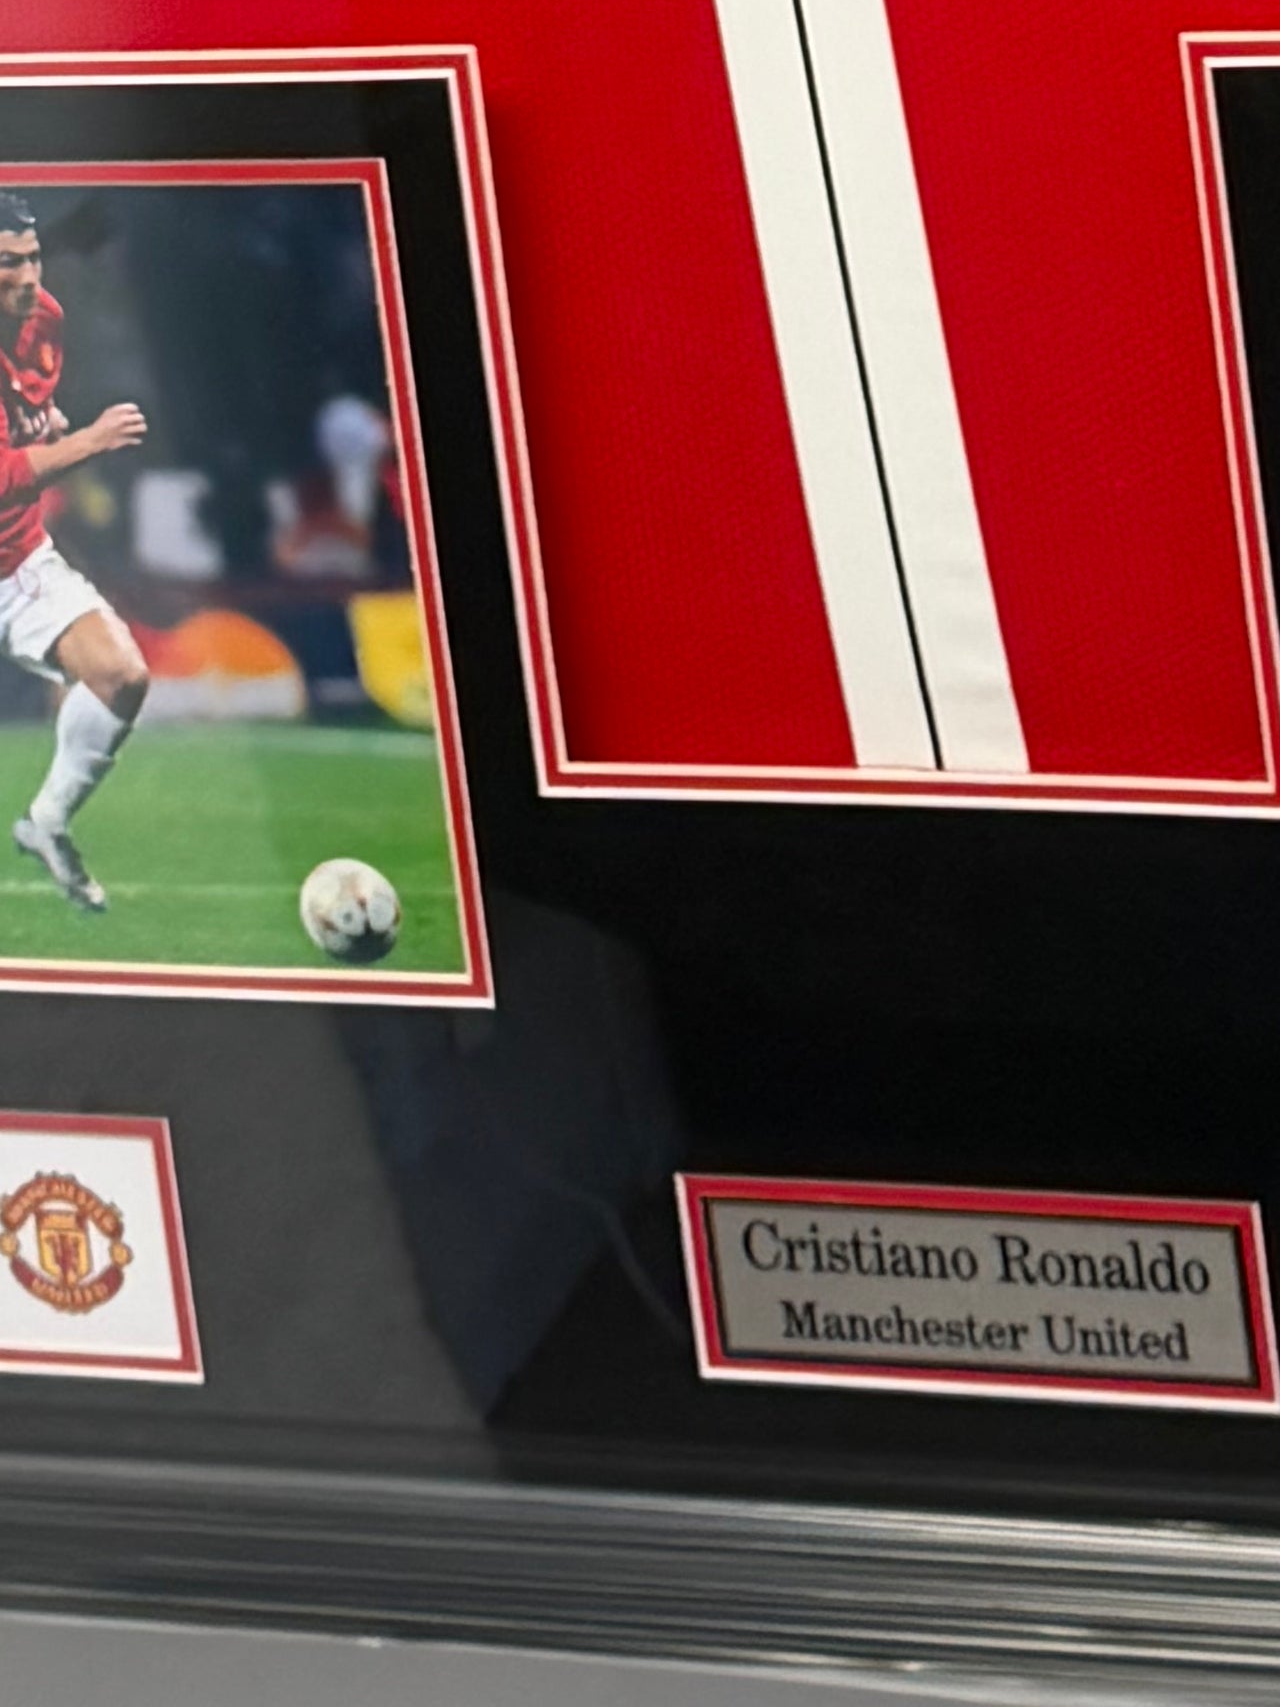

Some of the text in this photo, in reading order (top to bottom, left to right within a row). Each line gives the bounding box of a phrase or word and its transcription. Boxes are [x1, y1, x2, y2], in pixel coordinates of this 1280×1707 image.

[742, 1218, 1211, 1296] Cristiano Ronaldo
[781, 1301, 1190, 1362] Manchester United
